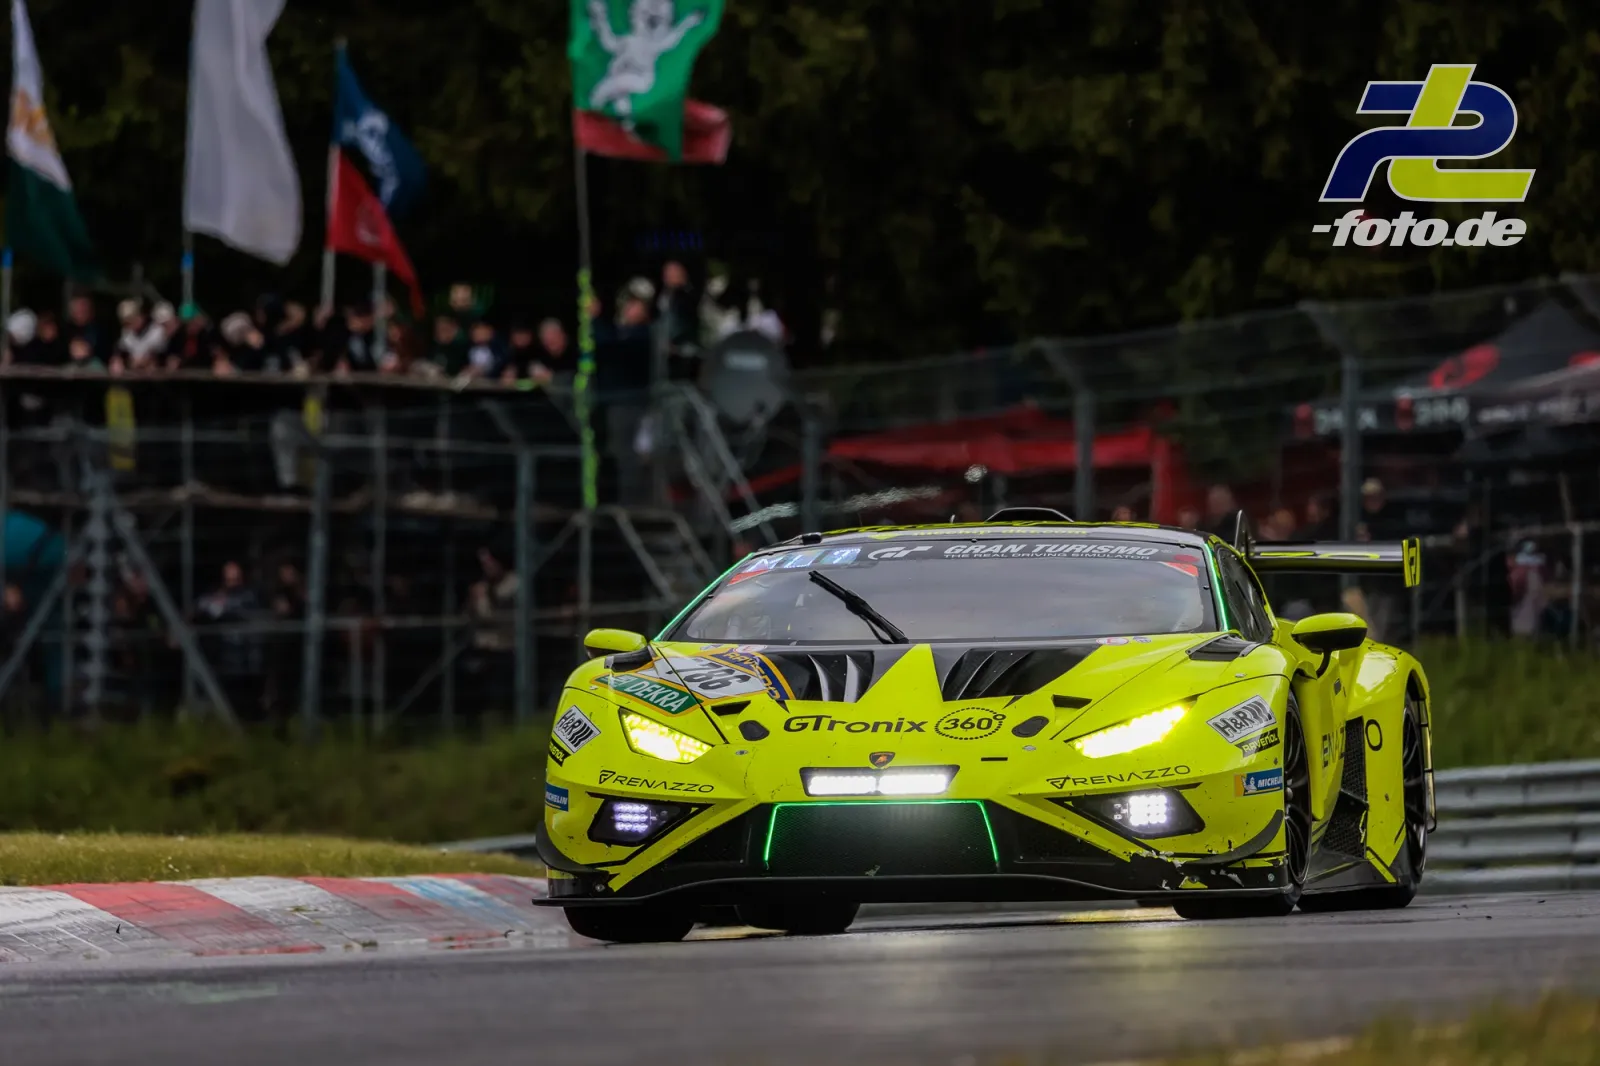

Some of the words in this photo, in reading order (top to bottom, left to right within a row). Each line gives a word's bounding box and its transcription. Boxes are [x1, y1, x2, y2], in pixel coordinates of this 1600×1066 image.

[943, 543, 1028, 554] GRAN
[1031, 544, 1160, 556] TURISMO
[1071, 552, 1150, 560] SIMULATOR
[665, 662, 752, 691] 786
[624, 680, 690, 712] DEKRA
[783, 714, 929, 733] GTronix
[1212, 710, 1255, 737] H&R
[612, 775, 715, 793] RENAZZO
[1071, 764, 1192, 786] RENAZZO
